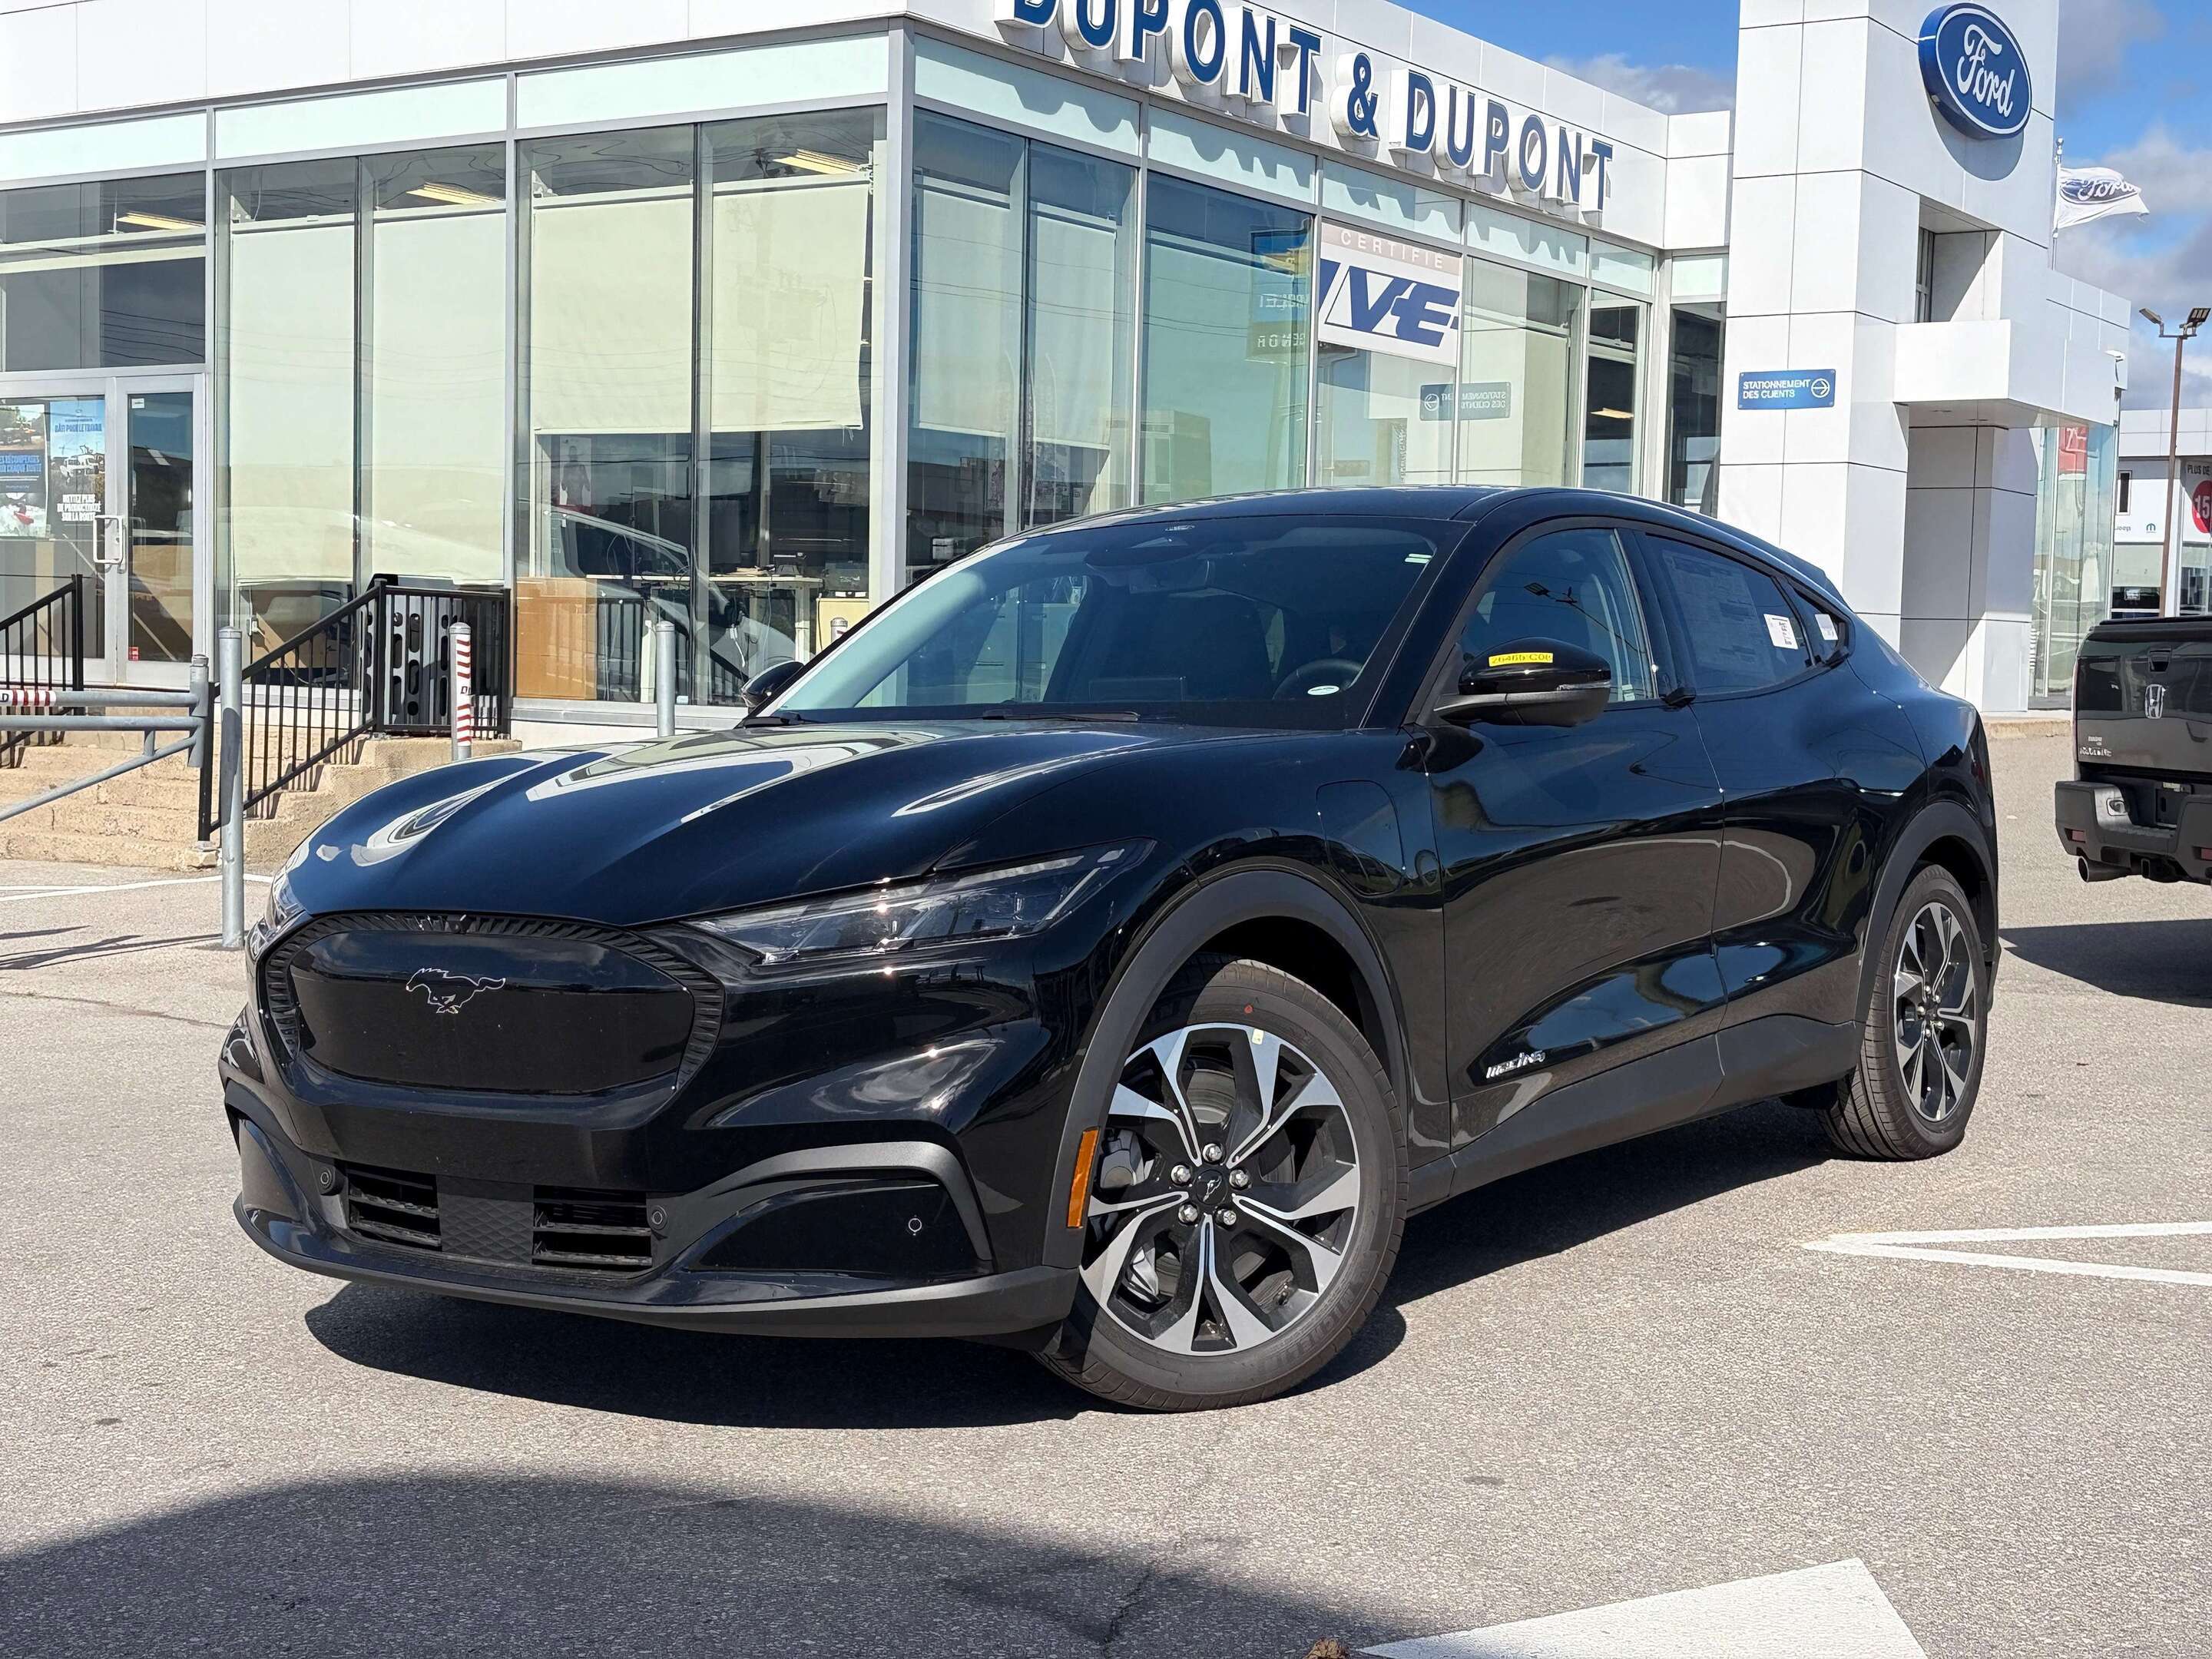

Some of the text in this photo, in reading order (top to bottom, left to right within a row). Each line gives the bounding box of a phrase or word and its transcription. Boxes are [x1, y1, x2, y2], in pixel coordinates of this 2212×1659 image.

[1957, 24, 2015, 117] Ford
[1013, 0, 1614, 212] UPONT & DUPONT
[1743, 379, 1811, 390] STATIONNEMENT
[1743, 389, 1795, 399] DES CLIENTS
[2187, 464, 2201, 475] PLUS
